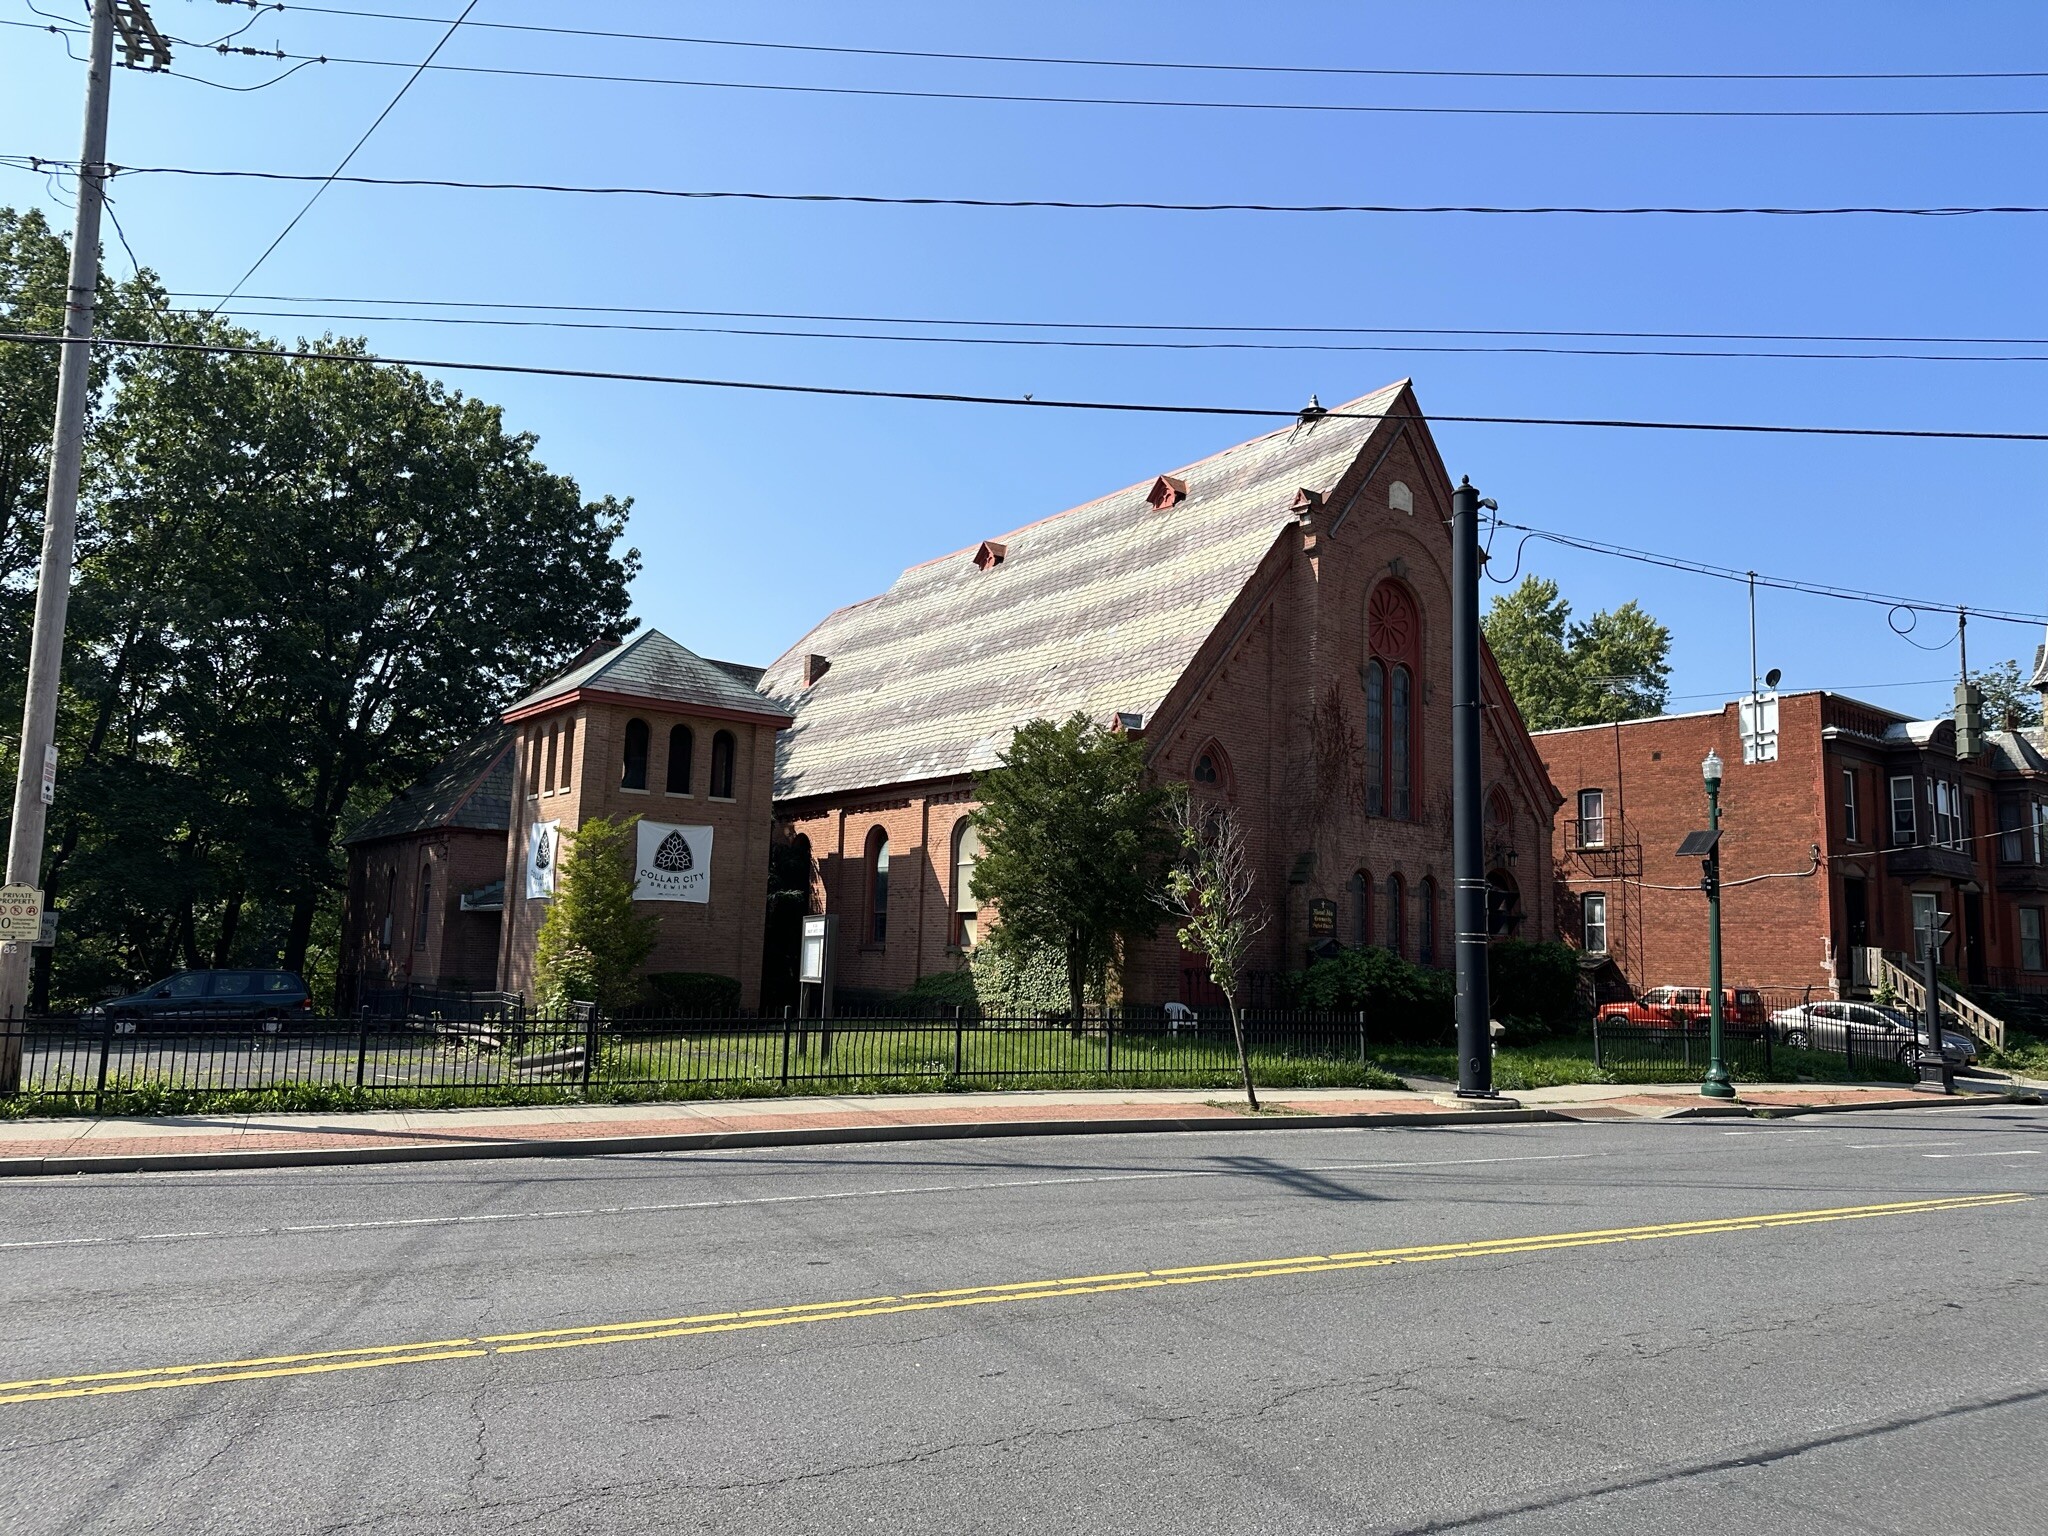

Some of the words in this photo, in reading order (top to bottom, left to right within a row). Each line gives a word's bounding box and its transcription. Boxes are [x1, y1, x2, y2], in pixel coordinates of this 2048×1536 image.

[640, 869, 680, 884] COLLAR
[683, 872, 705, 883] CITY
[650, 881, 695, 890] BREWING
[0, 917, 11, 929] O
[3, 945, 17, 954] 82
